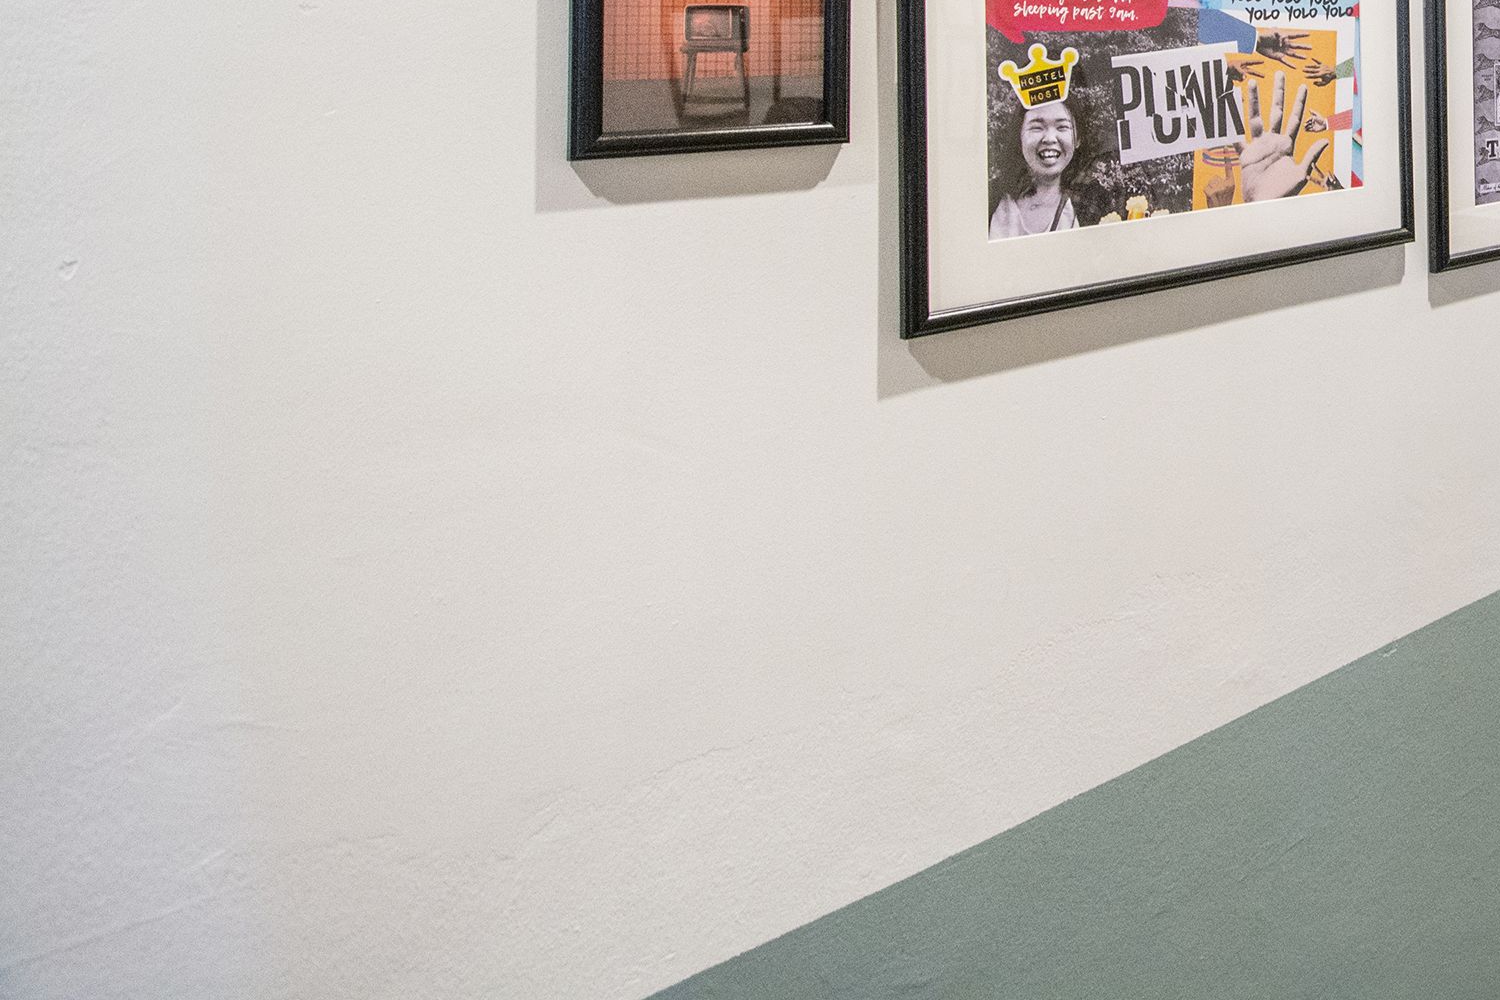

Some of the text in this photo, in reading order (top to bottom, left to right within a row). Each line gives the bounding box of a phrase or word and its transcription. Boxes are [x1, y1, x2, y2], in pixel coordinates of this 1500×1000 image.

[1013, 0, 1069, 24] sleeping
[1072, 3, 1105, 21] past
[1245, 4, 1354, 24] YOLO YOLO YOLO
[1020, 70, 1064, 88] HOSTEL
[1030, 88, 1058, 102] HOST
[1112, 58, 1245, 150] PUNK
